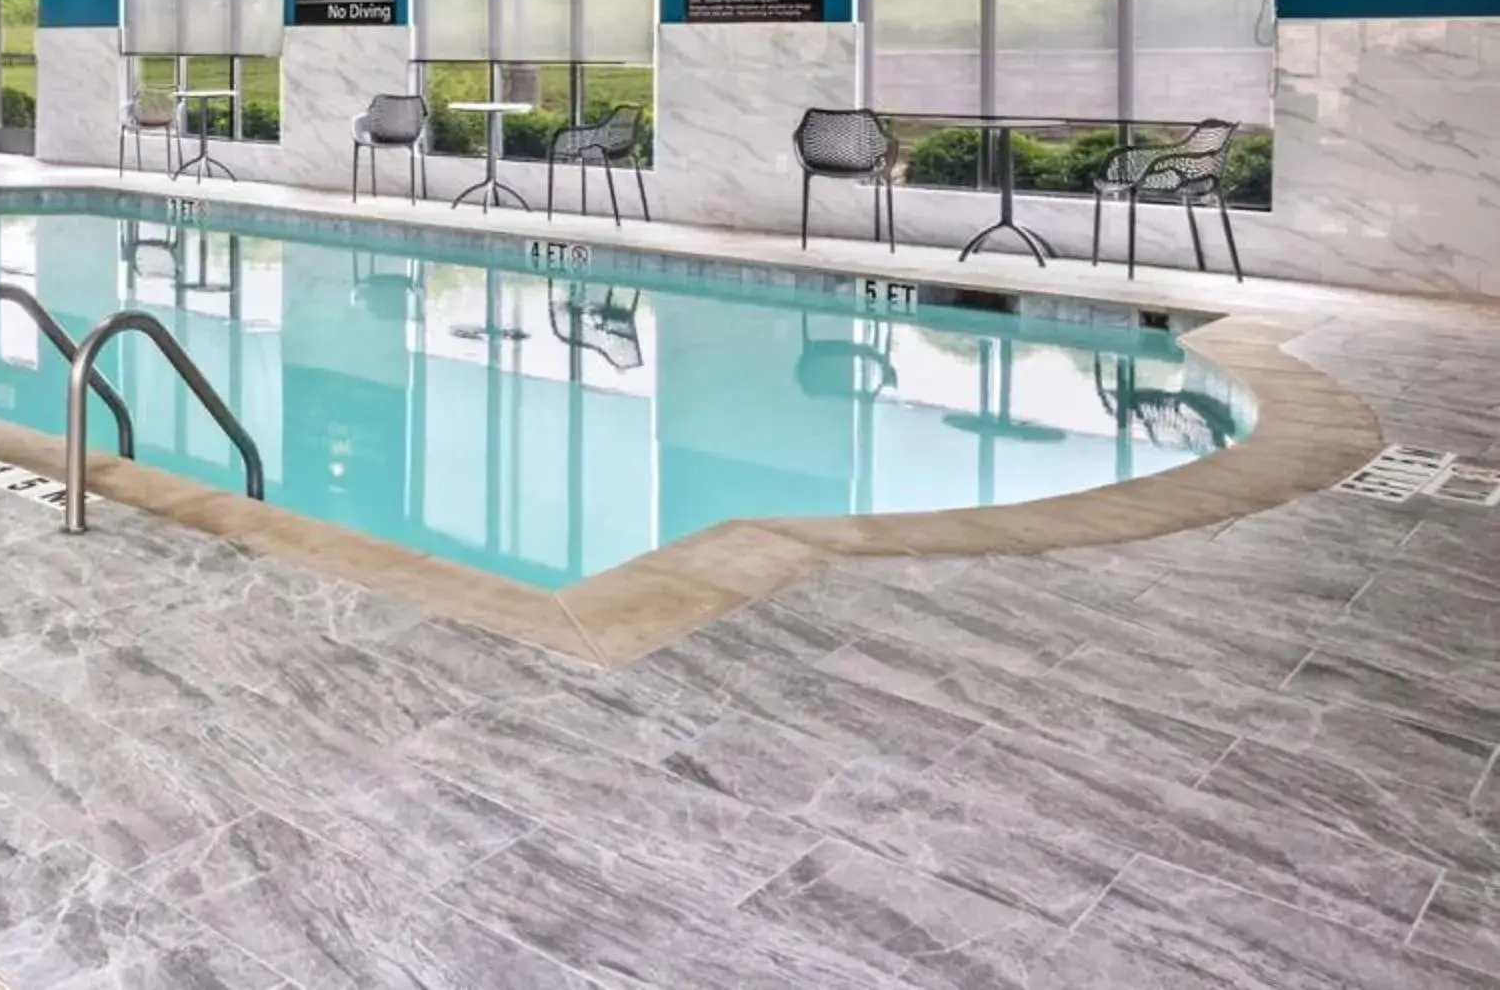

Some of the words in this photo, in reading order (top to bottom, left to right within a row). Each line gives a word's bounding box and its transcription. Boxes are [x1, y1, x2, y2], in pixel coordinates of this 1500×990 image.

[327, 3, 347, 19] No
[349, 3, 392, 23] Diving
[865, 279, 877, 300] 5
[887, 282, 916, 303] FT
